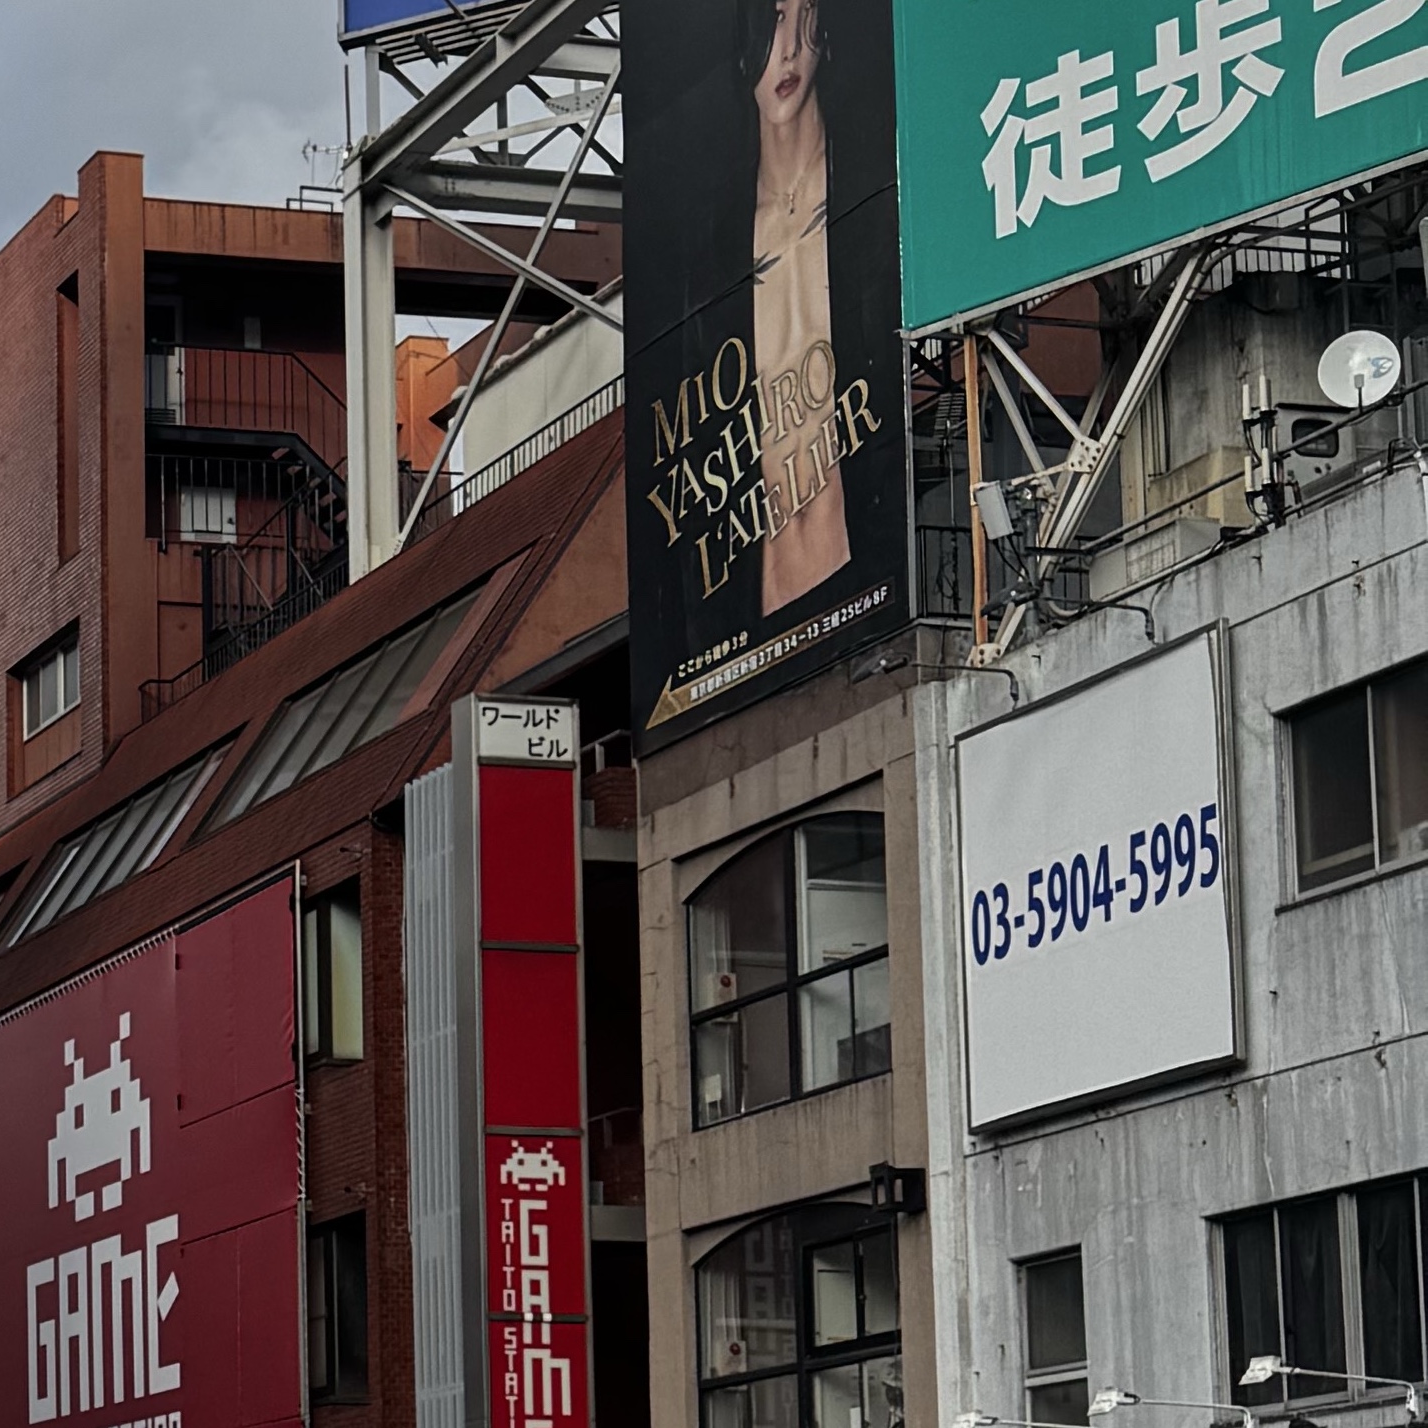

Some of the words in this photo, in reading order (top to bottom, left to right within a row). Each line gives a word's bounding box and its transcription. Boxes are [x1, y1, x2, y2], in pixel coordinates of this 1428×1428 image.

[645, 338, 838, 548] YASHIRO
[649, 337, 749, 467] MIO
[694, 378, 883, 600] L'ATELIER
[481, 704, 561, 729] ワールド
[526, 734, 568, 760] ビル
[970, 803, 1220, 966] 03-5904-5995
[26, 1213, 181, 1425] GAME
[501, 1197, 517, 1313] TAITO
